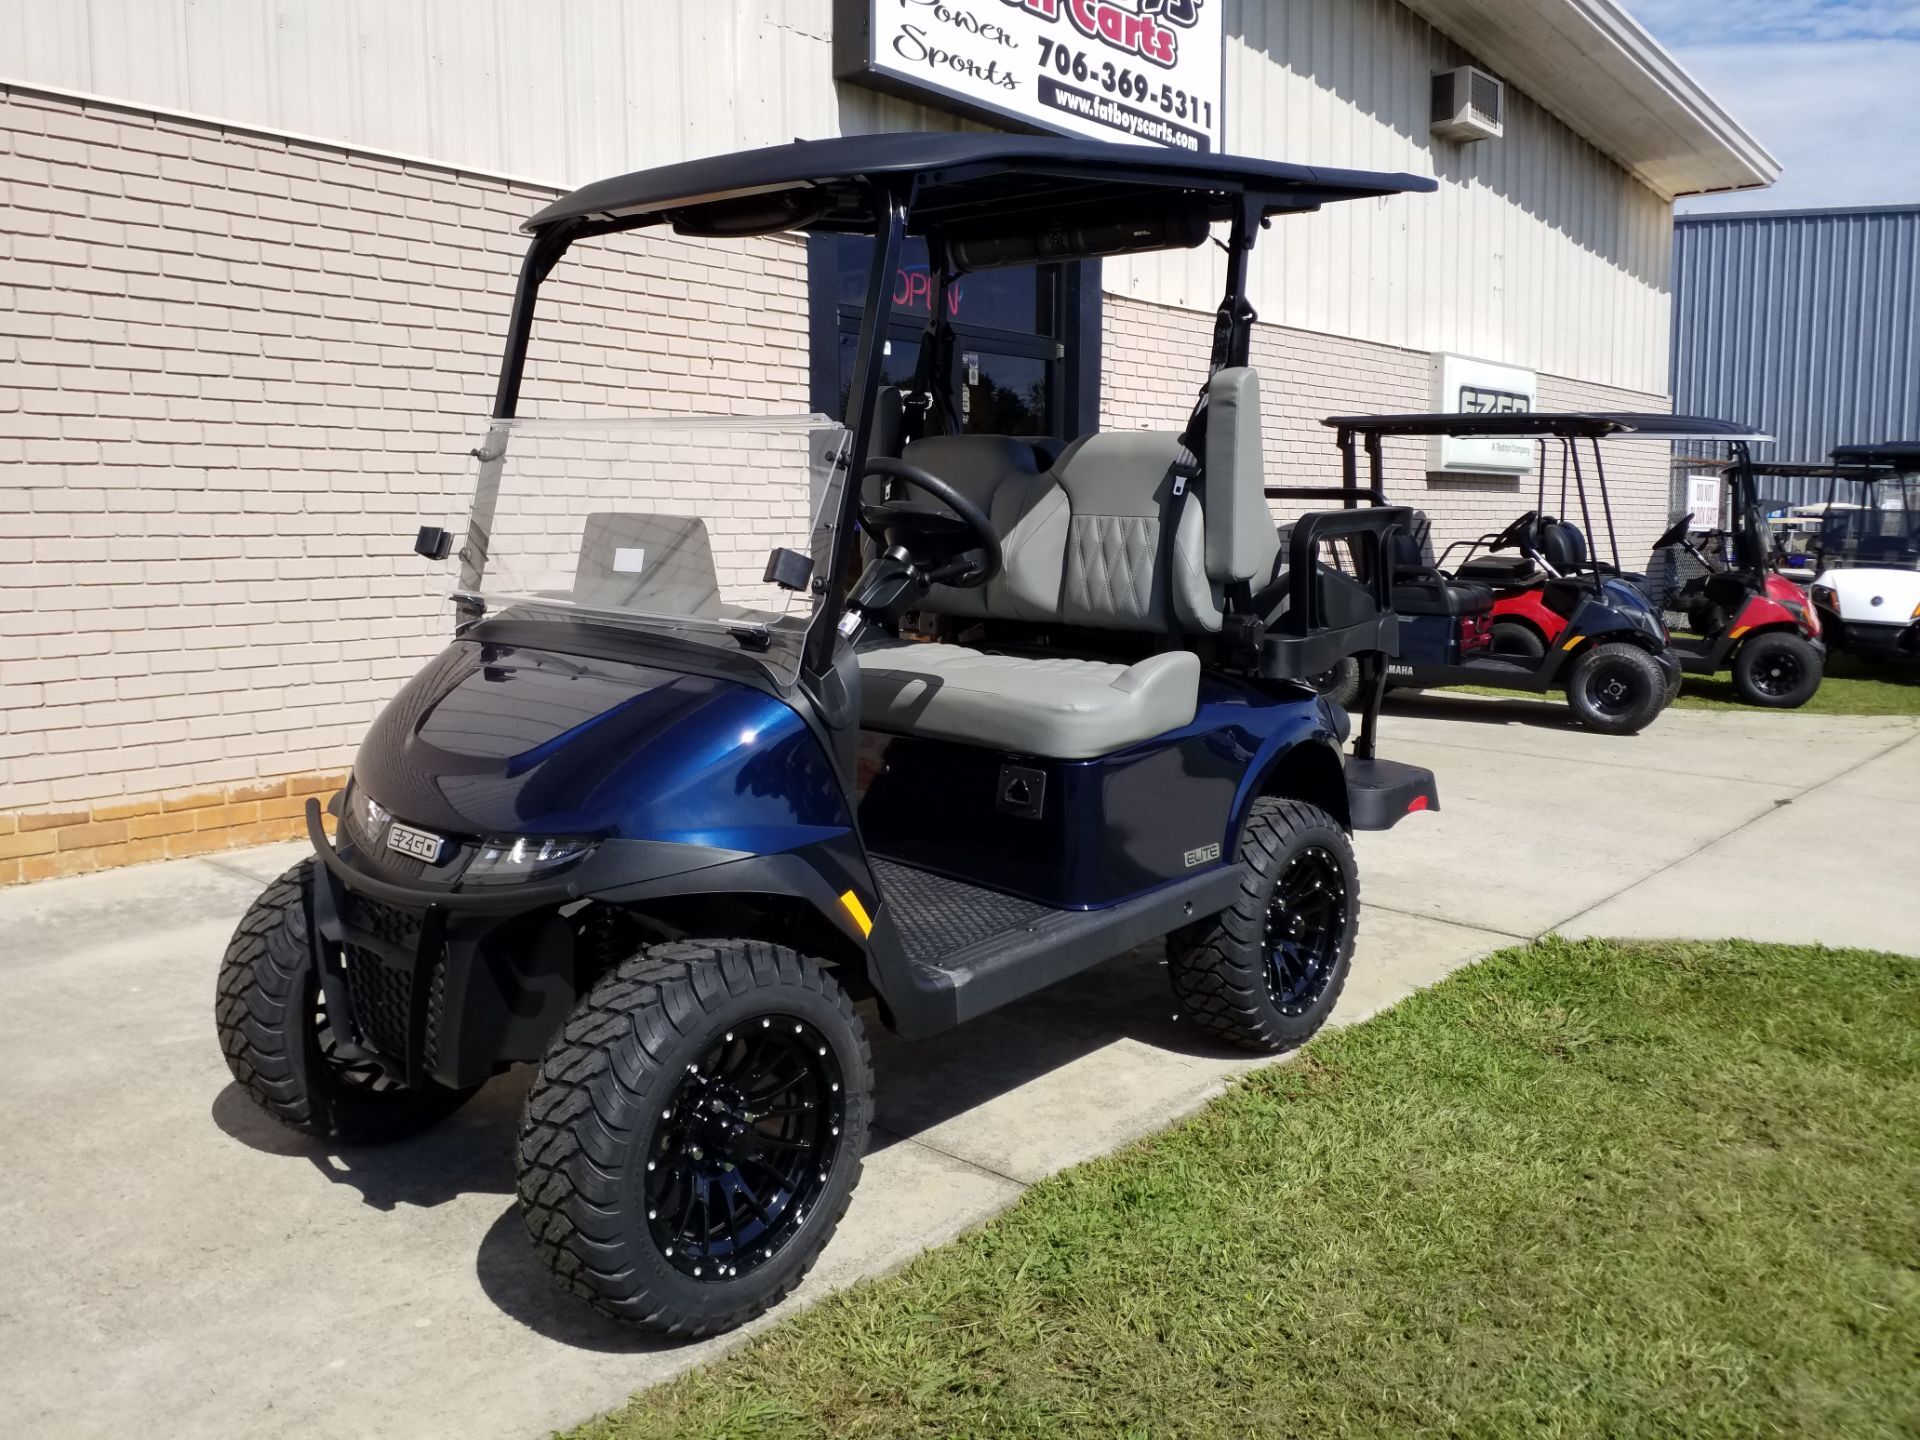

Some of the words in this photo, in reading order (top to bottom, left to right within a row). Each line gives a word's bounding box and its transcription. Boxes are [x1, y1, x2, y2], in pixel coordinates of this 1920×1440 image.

[900, 0, 1019, 48] ower
[1069, 0, 1177, 66] Carts
[893, 24, 1022, 90] Sports
[1038, 35, 1212, 130] 706-369-5311
[1055, 88, 1199, 152] www.fatboyscarts.com
[1386, 664, 1414, 676] MAHA
[389, 827, 438, 859] EZGO
[1187, 845, 1218, 864] ELITE
